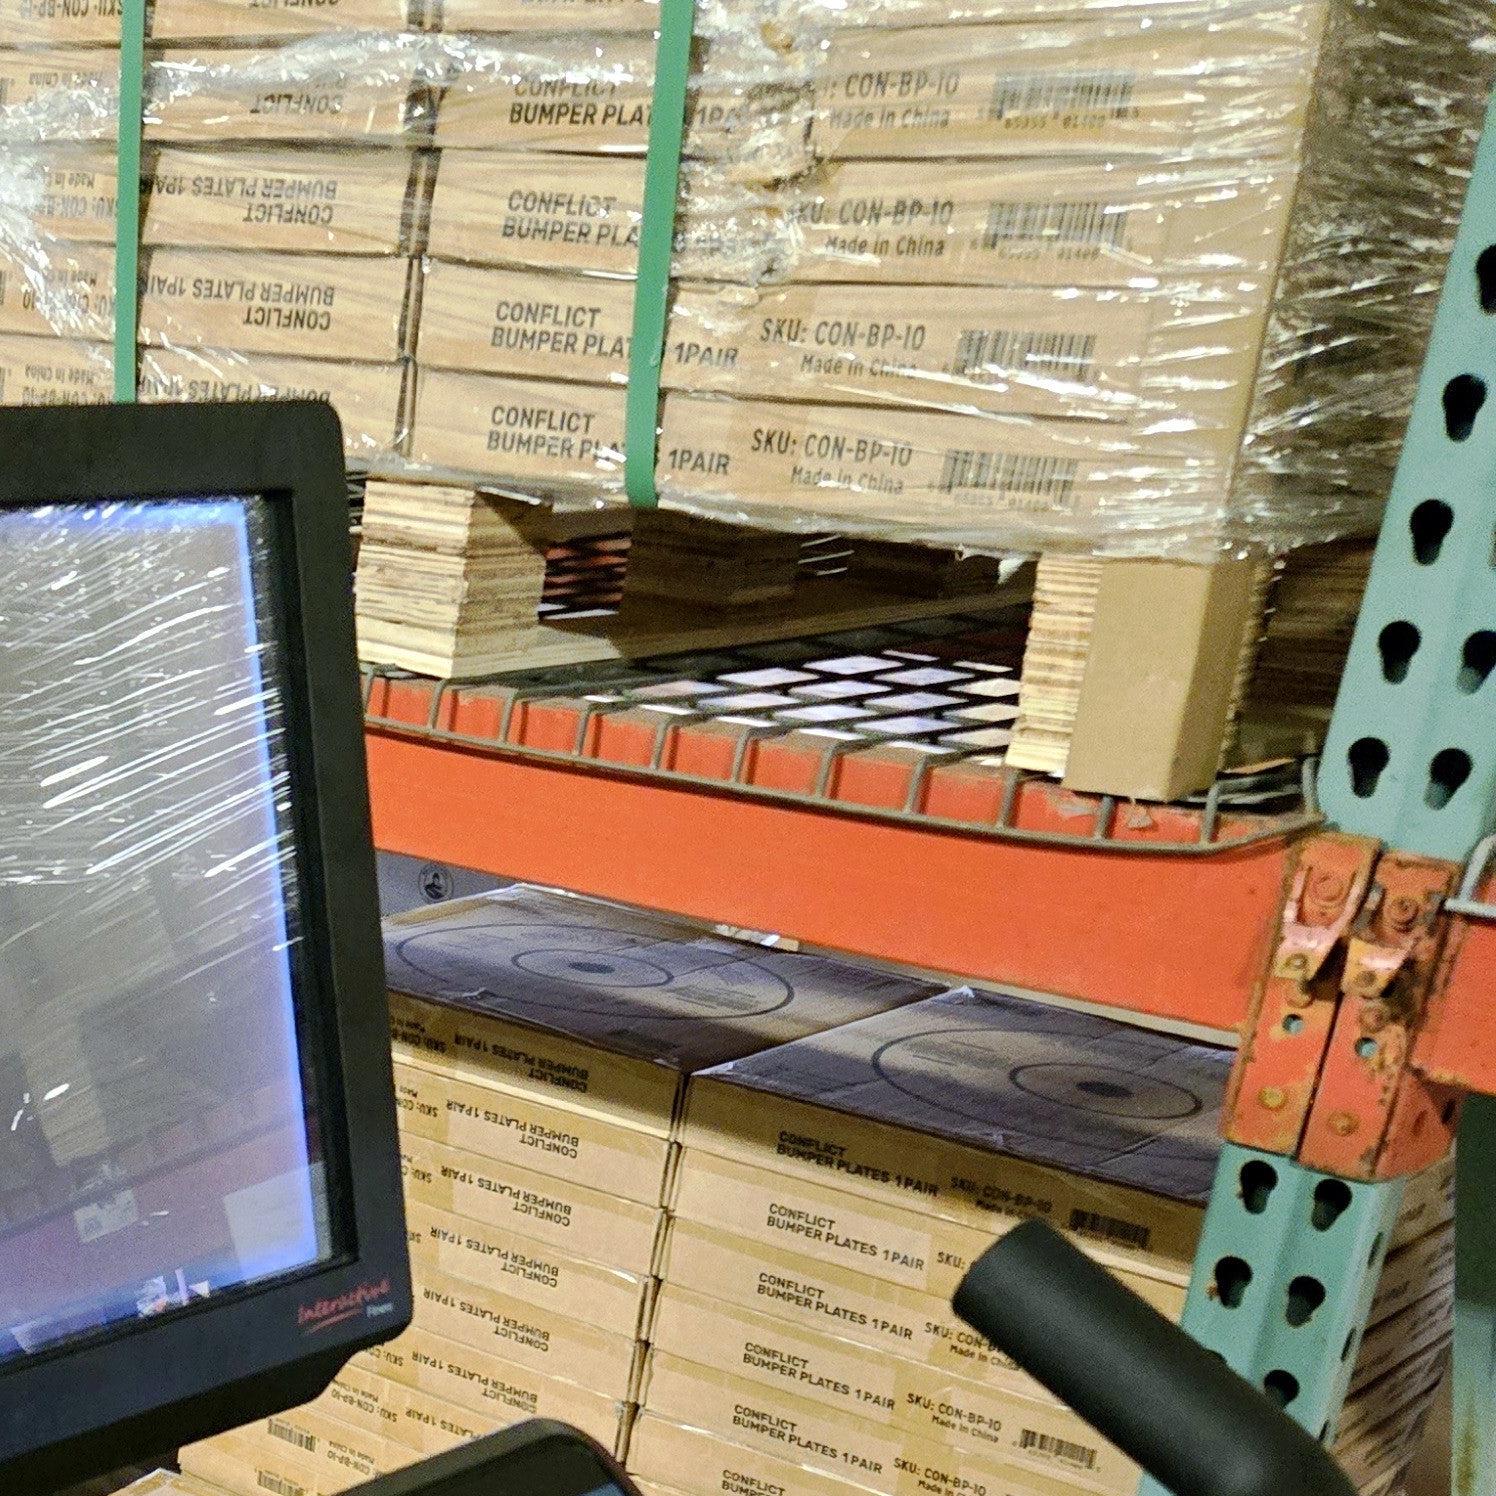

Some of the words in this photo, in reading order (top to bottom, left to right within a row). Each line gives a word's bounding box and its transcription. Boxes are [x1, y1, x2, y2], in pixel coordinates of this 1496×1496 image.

[845, 70, 960, 99] CON-BP-10
[250, 93, 344, 116] CONFLICT
[509, 102, 598, 125] BUMPER
[192, 176, 255, 198] PLATES
[260, 177, 338, 200] BUMPER
[243, 202, 333, 225] CONFLICT
[508, 190, 617, 217] CONFLICT
[839, 201, 954, 227] CON-BP-10
[502, 216, 592, 244] BUMPER
[825, 234, 868, 255] Made
[872, 233, 889, 254] in
[896, 233, 945, 256] China
[192, 278, 254, 301] PLATES
[260, 284, 335, 307] BUMPER
[243, 306, 331, 331] CONFLICT
[496, 301, 601, 328] CONFLICT
[760, 317, 807, 343] SKU:
[814, 320, 926, 351] CON-BP-10
[491, 327, 578, 354] BUMPER
[674, 342, 739, 367] 1PAIR
[801, 354, 843, 375] Made
[848, 356, 864, 375] in
[491, 406, 596, 434] CONFLICT
[487, 431, 574, 459] BUMPER
[668, 449, 731, 475] 1PAIR
[751, 428, 798, 455] SKU:
[804, 433, 912, 467] CON-BP-10
[790, 466, 832, 487] Made
[836, 471, 853, 489] in
[858, 473, 903, 496] China
[446, 1100, 480, 1118] 1PAIR
[484, 1111, 527, 1132] PLATES
[520, 1133, 578, 1158] CONFLICT
[529, 1124, 579, 1147] BUMPER
[778, 1130, 848, 1158] CONFLICT
[441, 1165, 473, 1185] 1PAIR
[776, 1143, 835, 1169] BUMPER
[837, 1158, 891, 1184] PLATES
[895, 1174, 939, 1197] 1PAIR
[477, 1176, 520, 1198] PLATES
[513, 1201, 571, 1227] CONFLICT
[522, 1191, 572, 1215] BUMPER
[769, 1203, 836, 1231] CONFLICT
[430, 1226, 463, 1246] 1PAIR
[766, 1215, 823, 1241] BUMPER
[825, 1231, 879, 1257] PLATES
[882, 1249, 926, 1272] 1PAIR
[466, 1238, 508, 1260] PLATES
[937, 1251, 966, 1271] SKU:
[501, 1262, 558, 1288] CONFLICT
[511, 1252, 559, 1277] BUMPER
[423, 1288, 456, 1307] 1PAIR
[758, 1272, 825, 1300] CONFLICT
[460, 1301, 500, 1323] PLATES
[756, 1284, 812, 1310] BUMPER
[815, 1300, 868, 1325] PLATES
[871, 1318, 914, 1341] 1PAIR
[494, 1325, 549, 1352] CONFLICT
[503, 1314, 550, 1341] BUMPER
[925, 1322, 953, 1341] SKU:
[411, 1350, 444, 1370] 1PAIR
[744, 1342, 809, 1370] CONFLICT
[950, 1345, 978, 1360] Made
[448, 1363, 488, 1388] PLATES
[742, 1354, 797, 1380] BUMPER
[799, 1370, 851, 1396] PLATES
[855, 1387, 896, 1411] 1PAIR
[482, 1388, 537, 1414] CONFLICT
[490, 1378, 538, 1404] BUMPER
[377, 1407, 398, 1423] SKU:
[405, 1407, 436, 1426] 1PAIR
[734, 1404, 798, 1433] CONFLICT
[907, 1393, 935, 1412] SKU:
[938, 1402, 1002, 1432] CON-BP-10
[732, 1415, 786, 1442] BUMPER
[787, 1433, 838, 1460] PLATES
[842, 1452, 883, 1474] 1PAIR
[893, 1457, 921, 1476] SKU:
